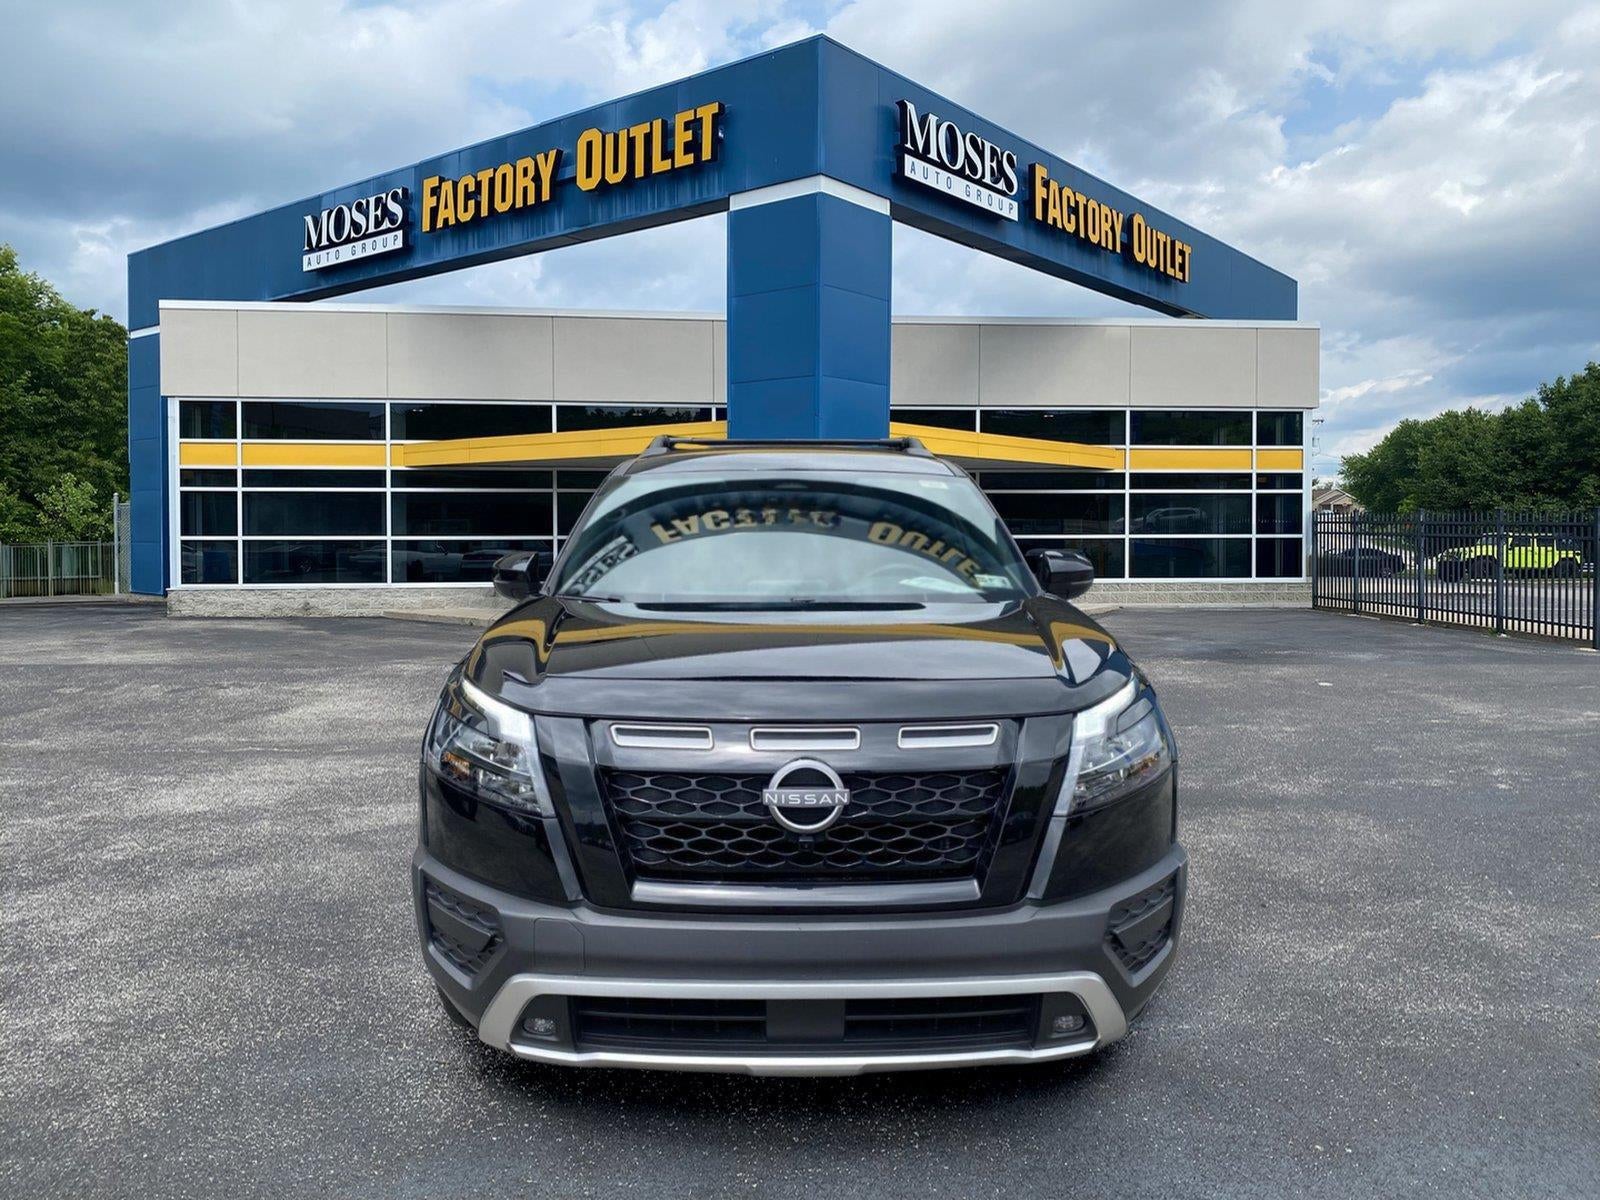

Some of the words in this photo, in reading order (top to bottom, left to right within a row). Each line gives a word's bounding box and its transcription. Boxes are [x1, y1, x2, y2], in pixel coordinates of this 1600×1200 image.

[421, 148, 559, 233] FACTORY
[576, 101, 721, 192] OUTLET
[904, 99, 1018, 196] MOSES
[302, 187, 404, 251] MOSES
[909, 161, 953, 190] AUTO
[964, 184, 1015, 215] GROUP
[306, 249, 341, 268] AUTO
[350, 234, 400, 256] GROUP
[1034, 162, 1124, 254] FACTORY
[1132, 212, 1192, 283] OUTLET
[764, 793, 849, 805] NISSAN
